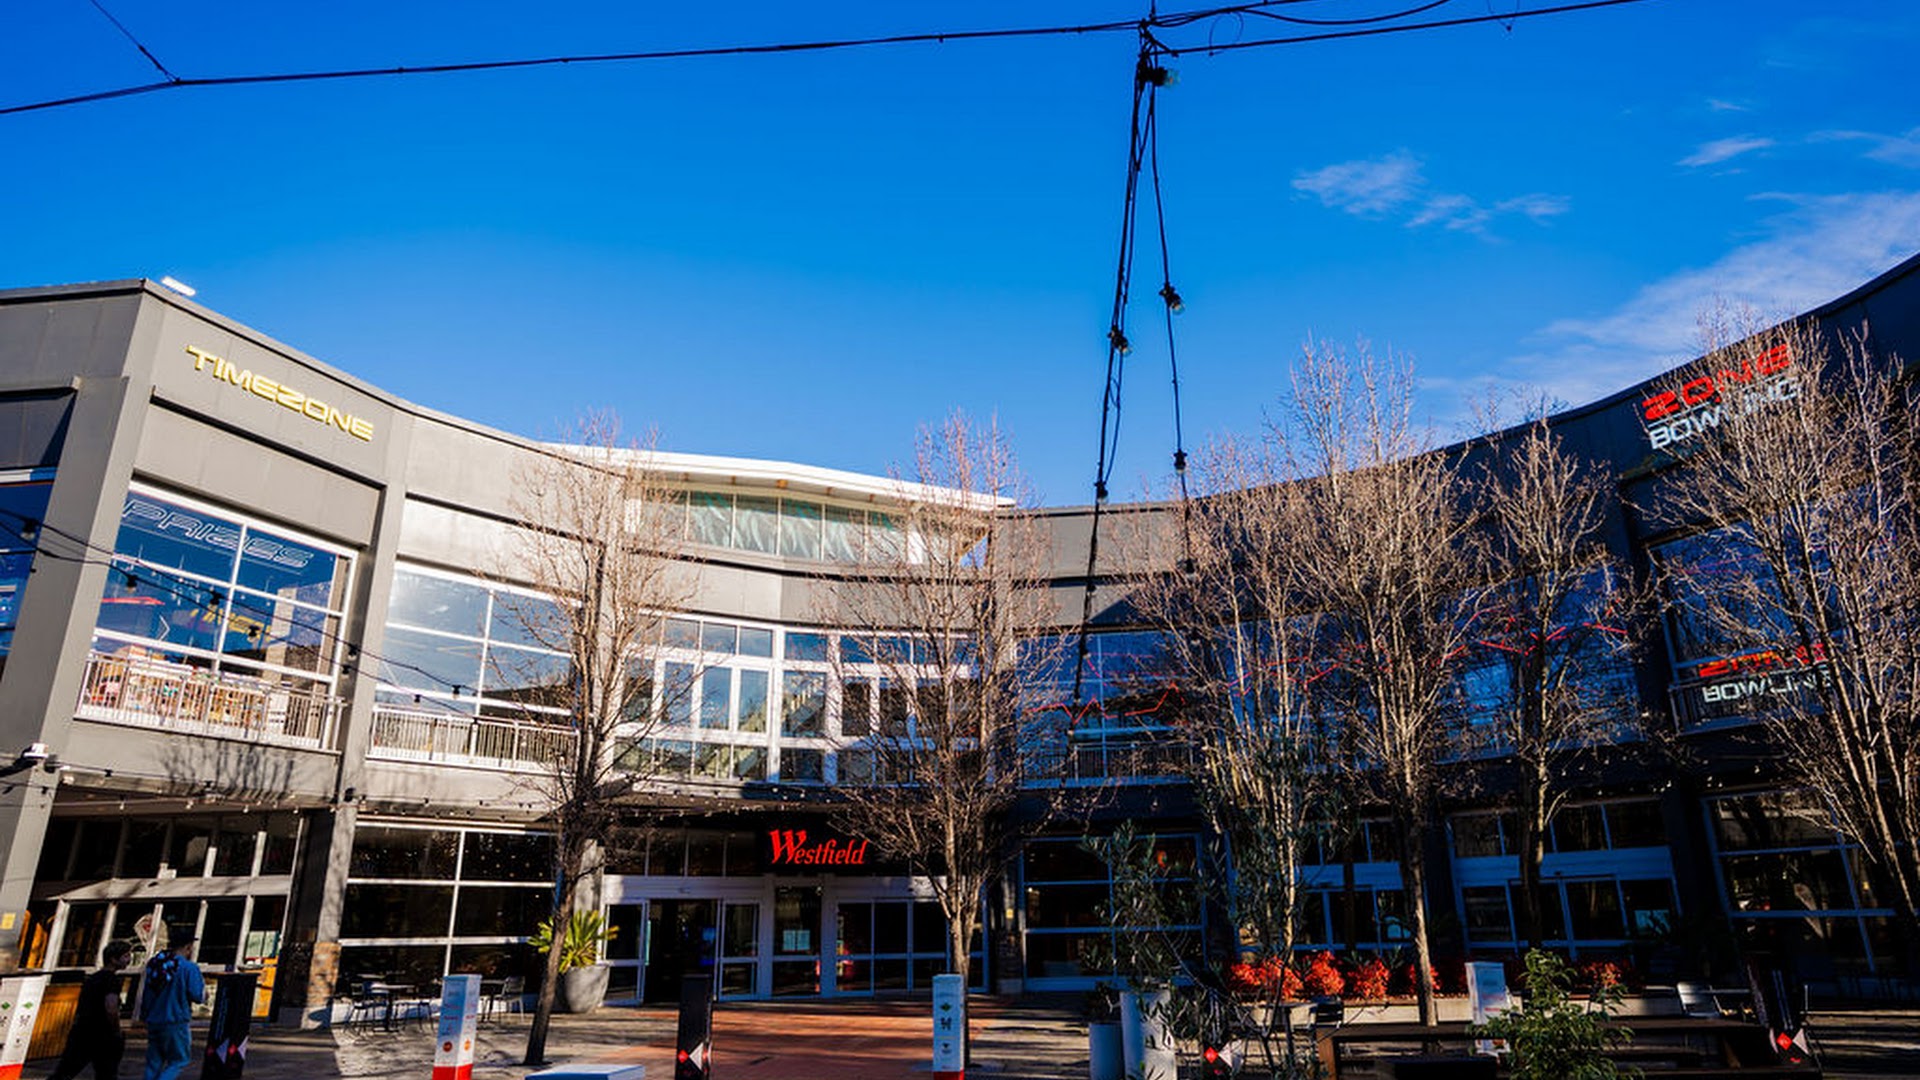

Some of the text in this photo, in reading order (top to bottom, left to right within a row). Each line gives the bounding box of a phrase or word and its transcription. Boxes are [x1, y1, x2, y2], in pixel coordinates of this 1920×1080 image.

[185, 344, 375, 442] TIMEZONE
[1642, 344, 1791, 420] ZONE
[1649, 376, 1800, 449] BOWING
[121, 499, 315, 568] PRIZES
[768, 828, 870, 865] Westfield
